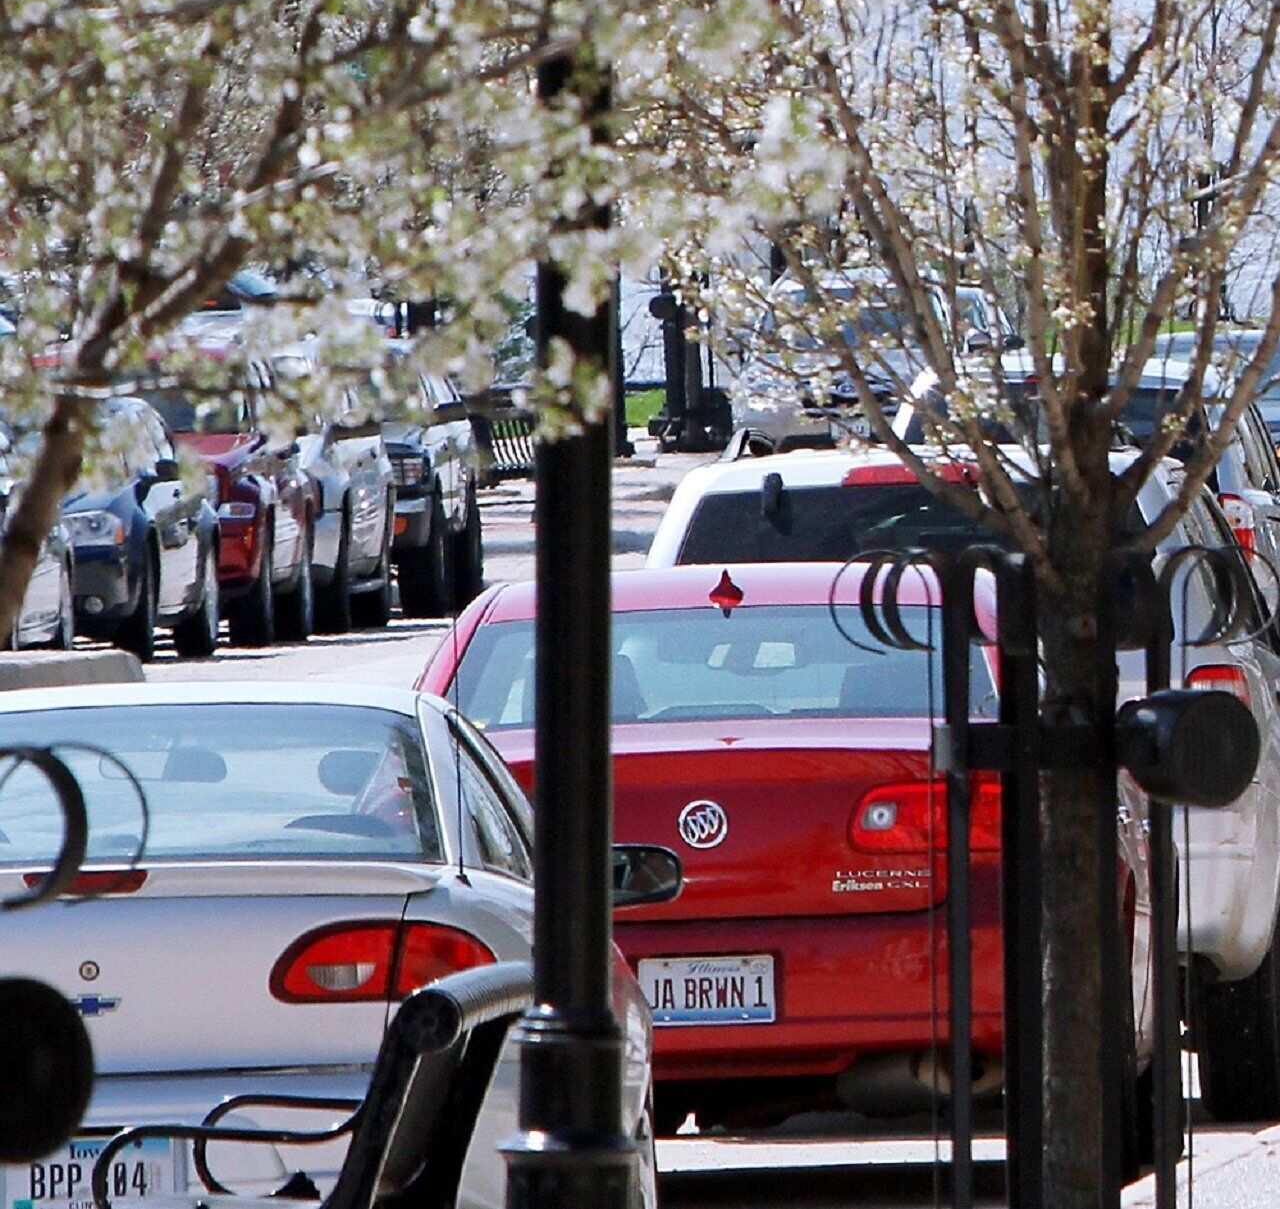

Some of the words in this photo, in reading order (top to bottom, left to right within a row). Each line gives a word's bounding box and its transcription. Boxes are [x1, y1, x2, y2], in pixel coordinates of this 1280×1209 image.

[836, 869, 932, 878] LUCERNE
[688, 961, 741, 974] Illinois
[684, 976, 745, 1009] BRWN
[753, 975, 768, 1008] 1
[69, 1143, 101, 1160] Iow
[30, 1163, 82, 1200] BPP
